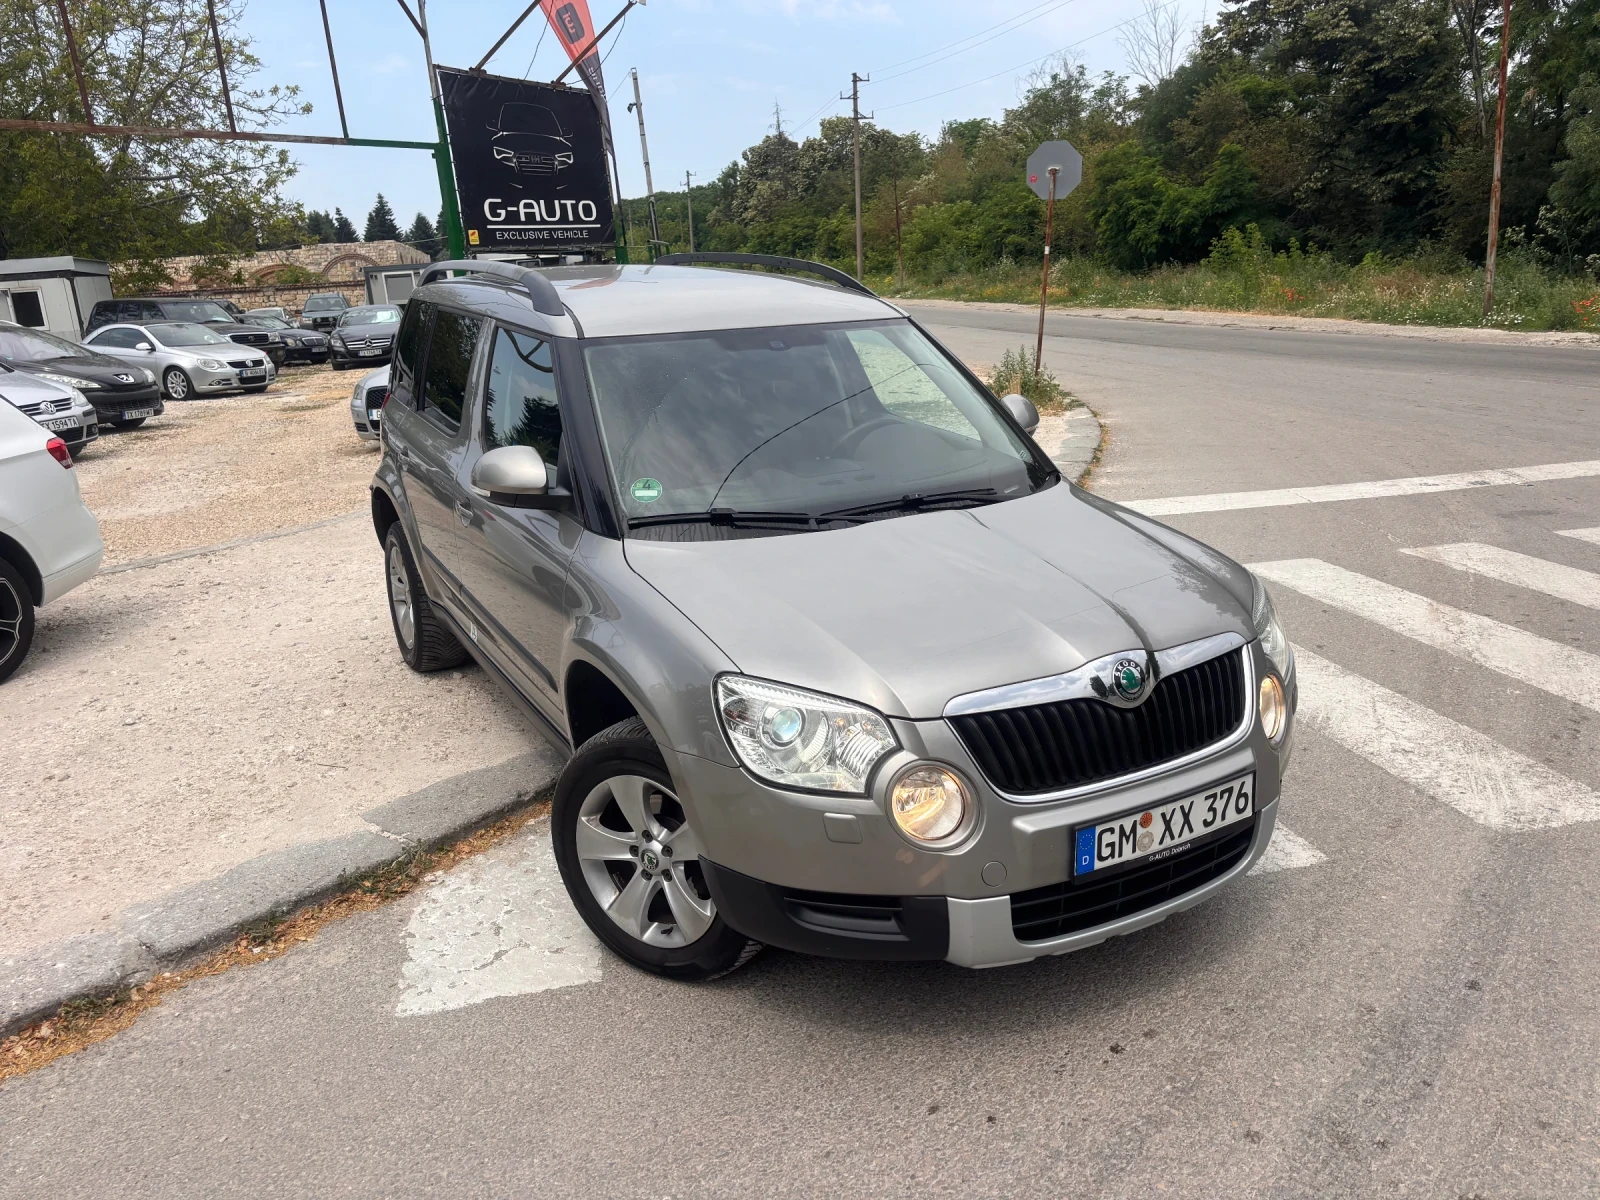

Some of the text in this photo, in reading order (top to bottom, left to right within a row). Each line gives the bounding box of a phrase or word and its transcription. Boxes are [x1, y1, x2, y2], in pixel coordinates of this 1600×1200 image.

[483, 198, 597, 222] G-AUTO
[496, 229, 589, 240] EXCLUSIVE VEHICLE
[52, 419, 69, 430] 1594
[69, 418, 78, 427] TA
[1096, 780, 1249, 862] GM XX 376
[1081, 855, 1090, 866] D
[1149, 850, 1170, 861] G-AUTO
